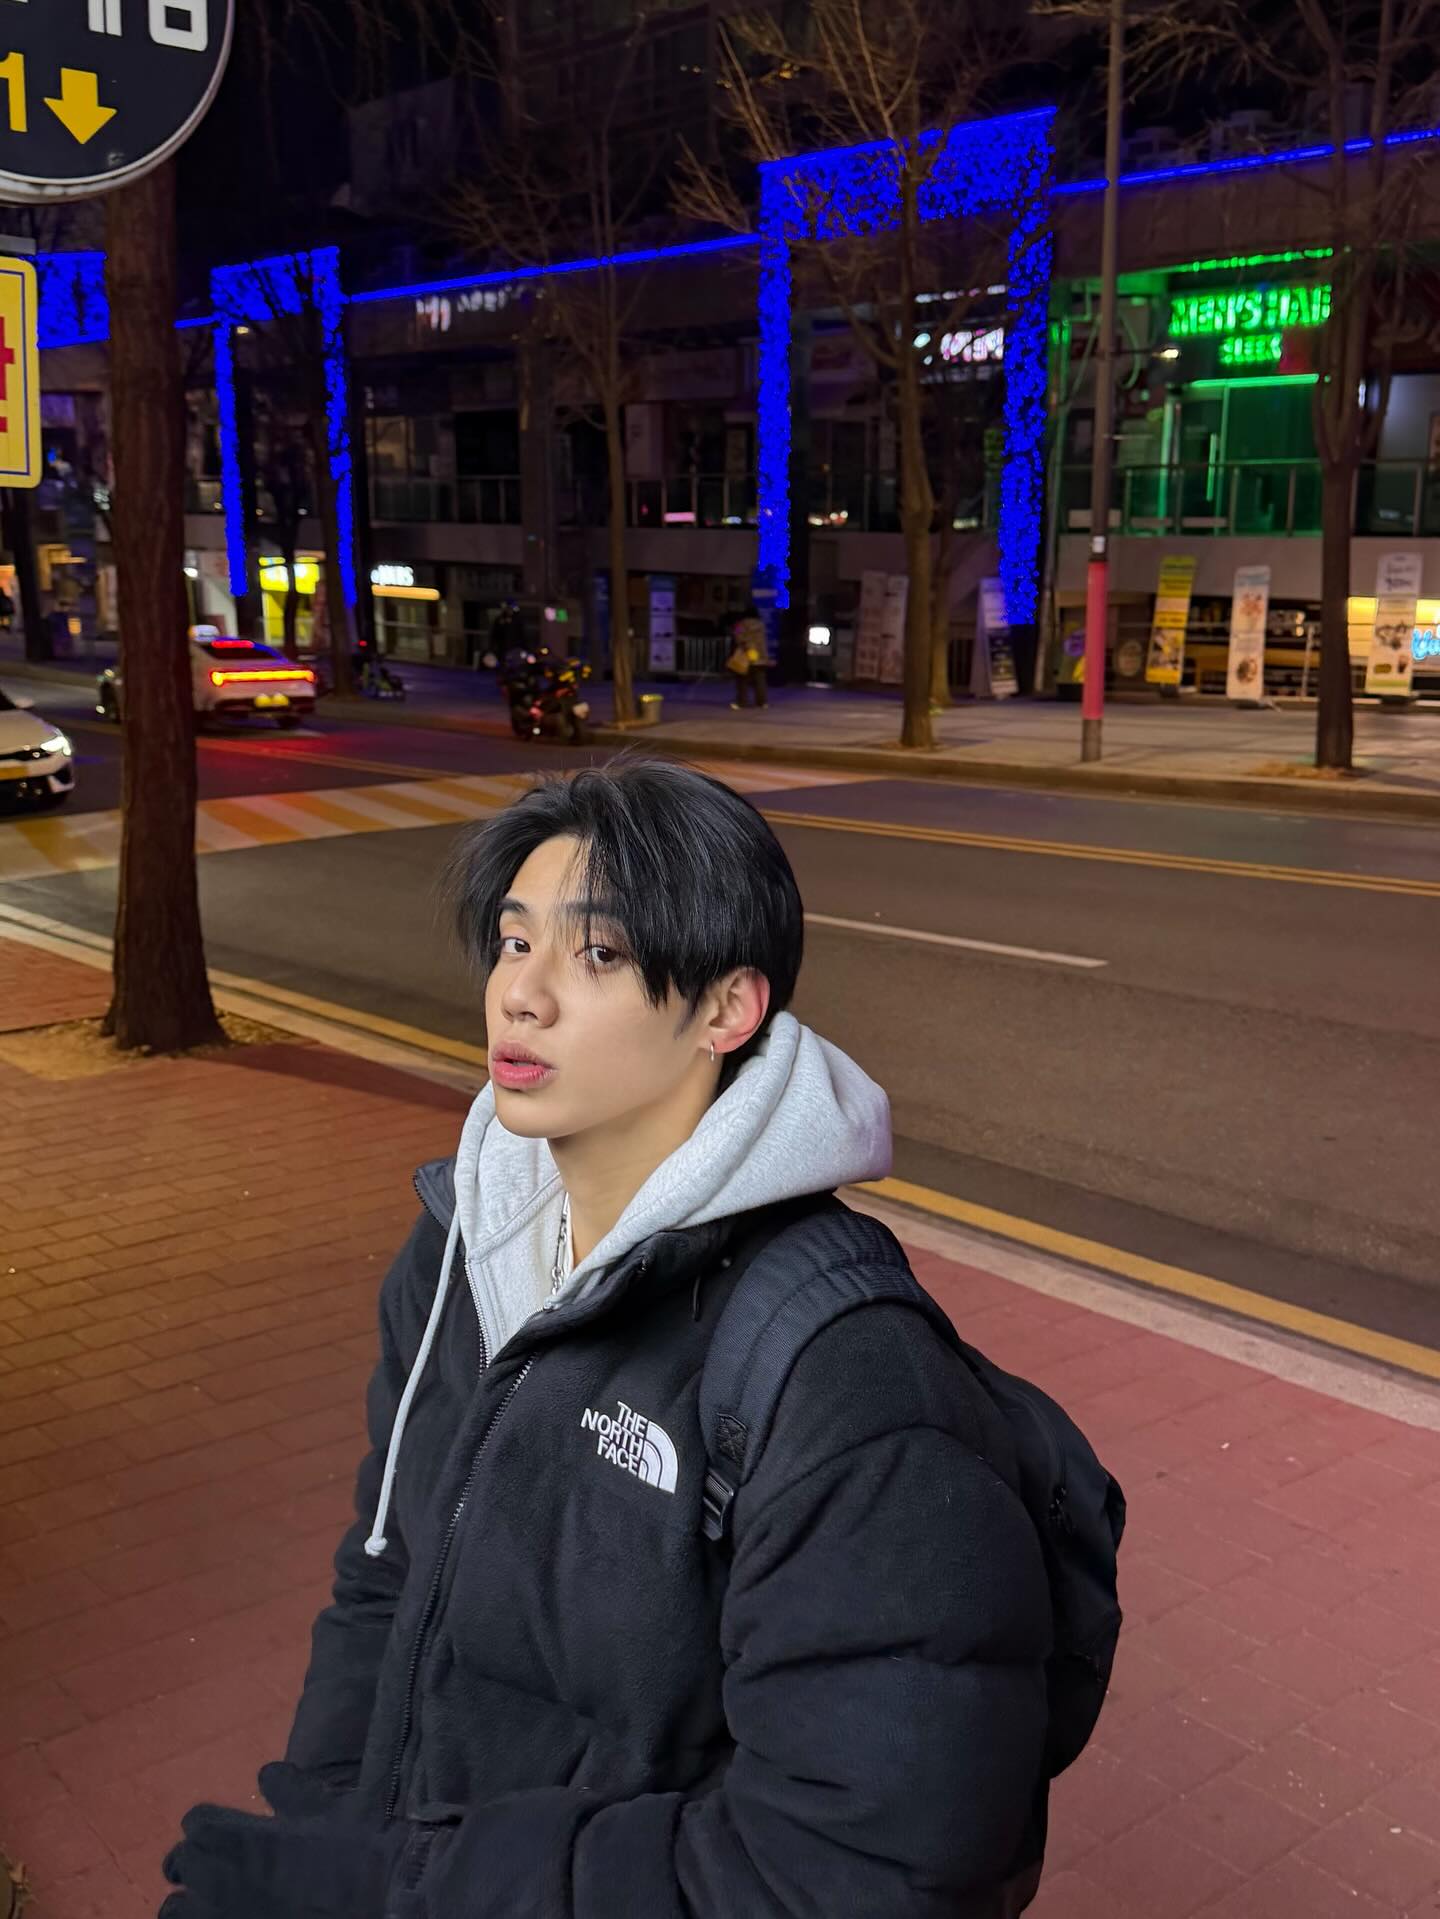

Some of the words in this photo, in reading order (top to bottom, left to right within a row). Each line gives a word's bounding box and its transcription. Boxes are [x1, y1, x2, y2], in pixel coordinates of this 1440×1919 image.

[580, 1407, 644, 1459] NORTH
[617, 1400, 649, 1439] THE
[597, 1434, 639, 1477] FACE
